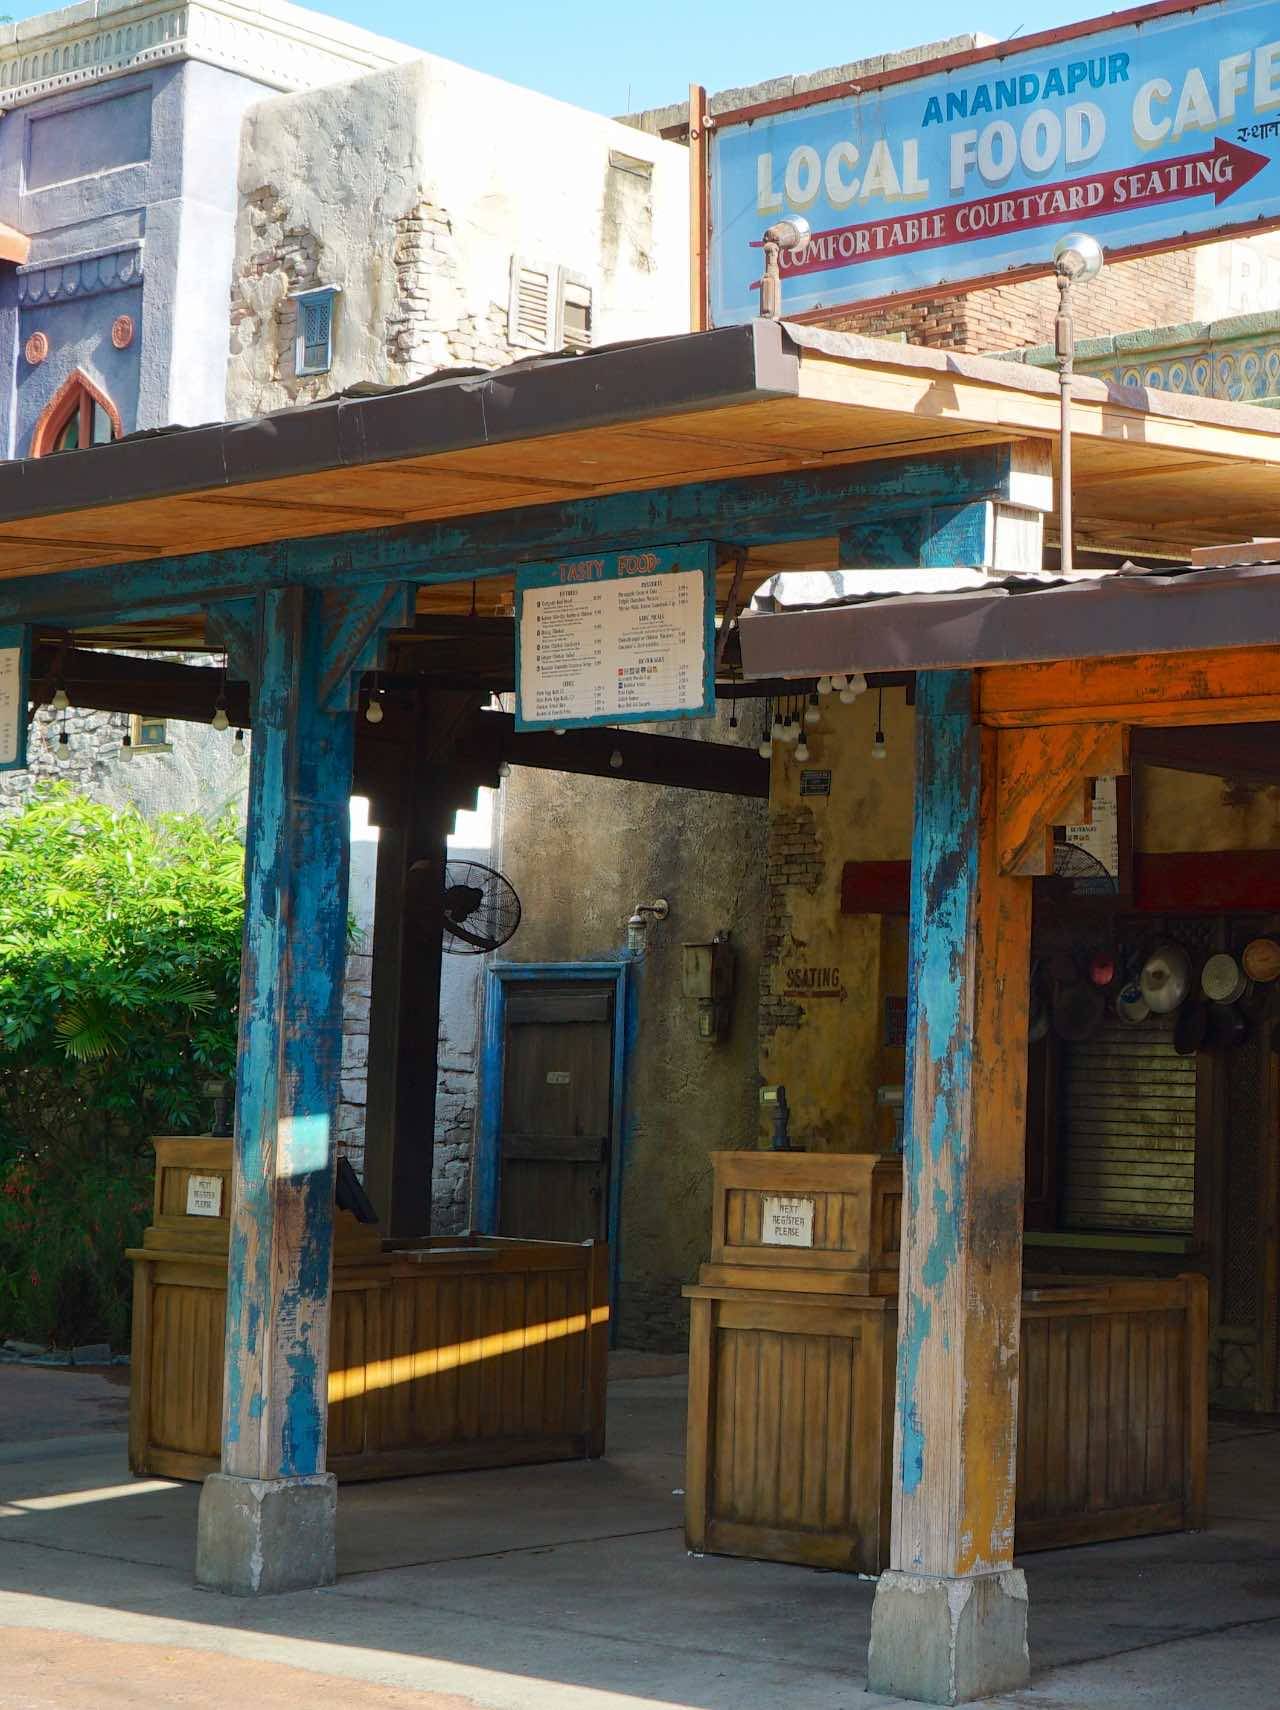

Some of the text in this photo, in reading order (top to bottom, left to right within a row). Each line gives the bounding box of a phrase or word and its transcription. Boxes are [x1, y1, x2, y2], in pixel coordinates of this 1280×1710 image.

[921, 52, 1131, 127] ANANDAPUR
[756, 136, 929, 214] LOCAL
[950, 103, 1107, 194] FOOD
[779, 153, 1235, 271] COMFORTABLE COURTYARD SEATING
[559, 554, 657, 582] TASTY FOOD
